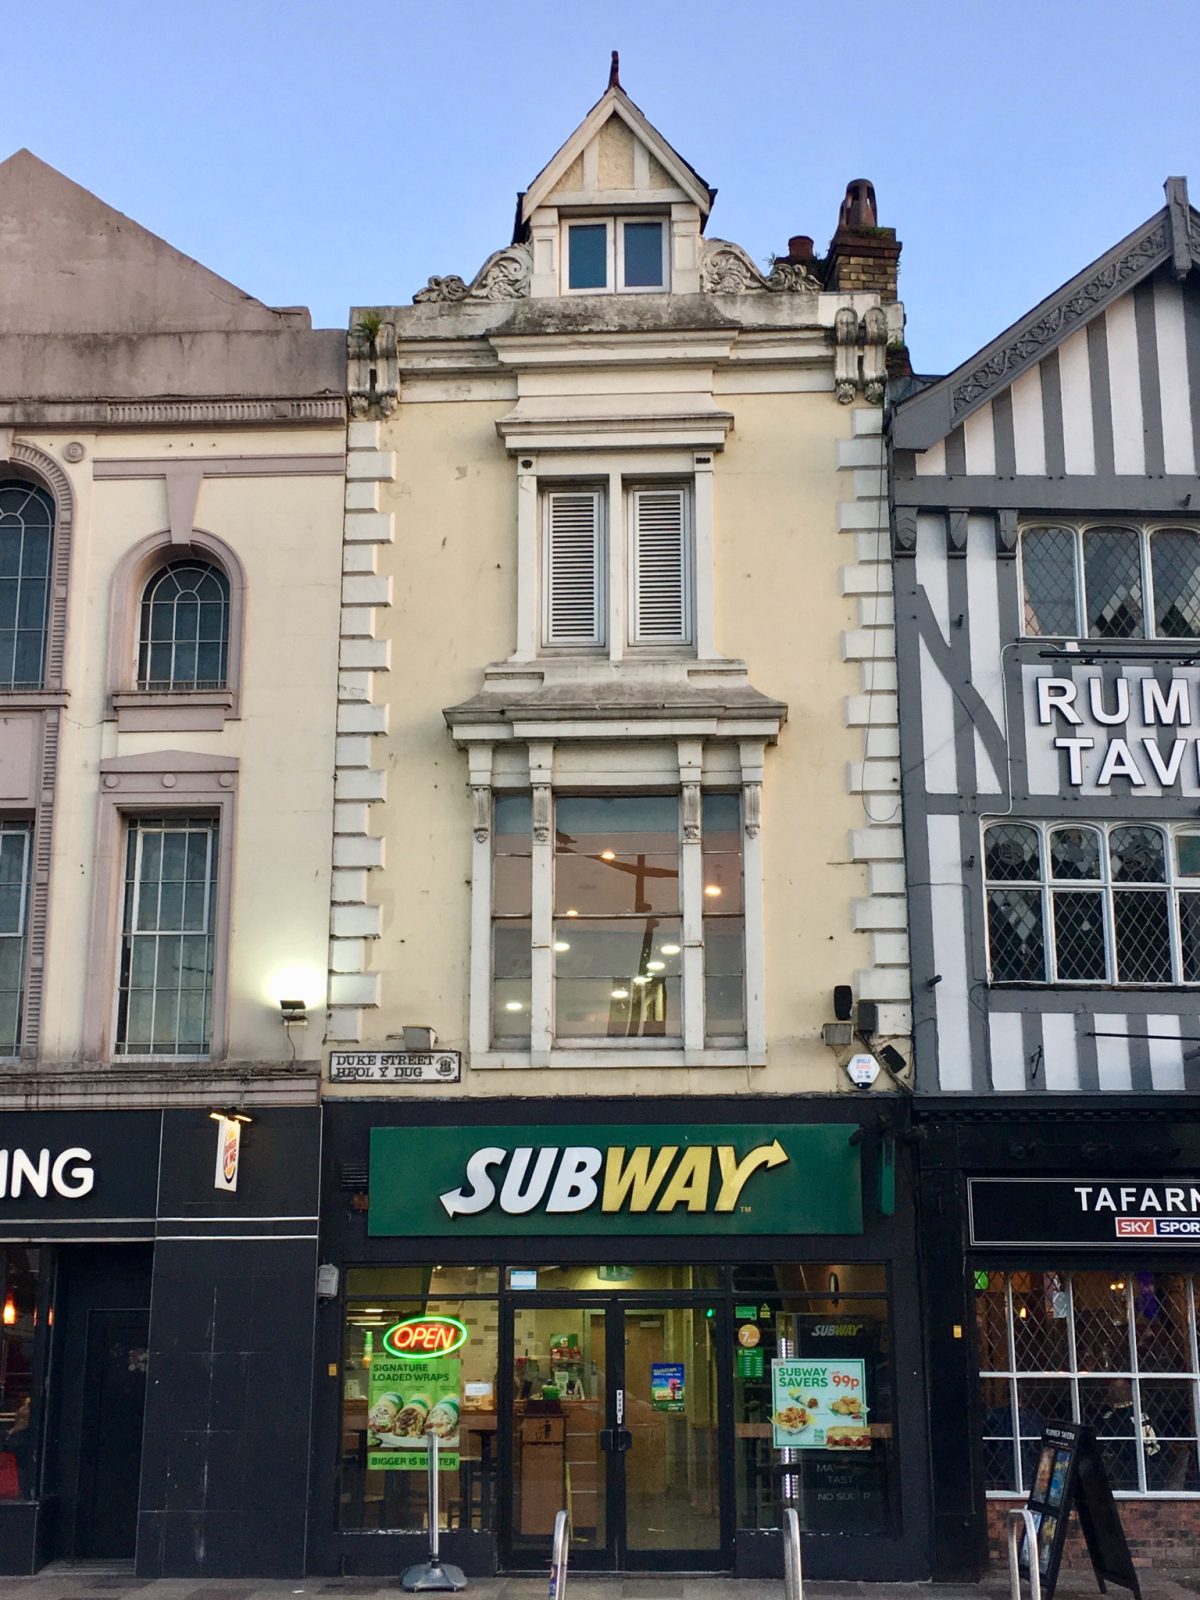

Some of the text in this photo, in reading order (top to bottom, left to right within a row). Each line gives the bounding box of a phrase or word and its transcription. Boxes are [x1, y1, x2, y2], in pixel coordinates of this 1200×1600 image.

[336, 1055, 434, 1066] DUKE STREET
[336, 1067, 374, 1078] HEOL
[379, 1066, 389, 1077] Y
[394, 1067, 423, 1077] DUG
[0, 1147, 94, 1198] ING
[438, 1138, 789, 1218] SUBWAY
[1121, 1222, 1150, 1232] SKY
[811, 1324, 863, 1337] SUBWAY
[393, 1326, 455, 1349] OPEN
[373, 1364, 429, 1372] SIGNATURE
[778, 1368, 828, 1377] SUBWAY
[373, 1373, 450, 1381] LOADED WRAPS
[778, 1375, 860, 1390] SAVERS 99p
[371, 1457, 406, 1466] BIGGER
[408, 1457, 417, 1466] IS
